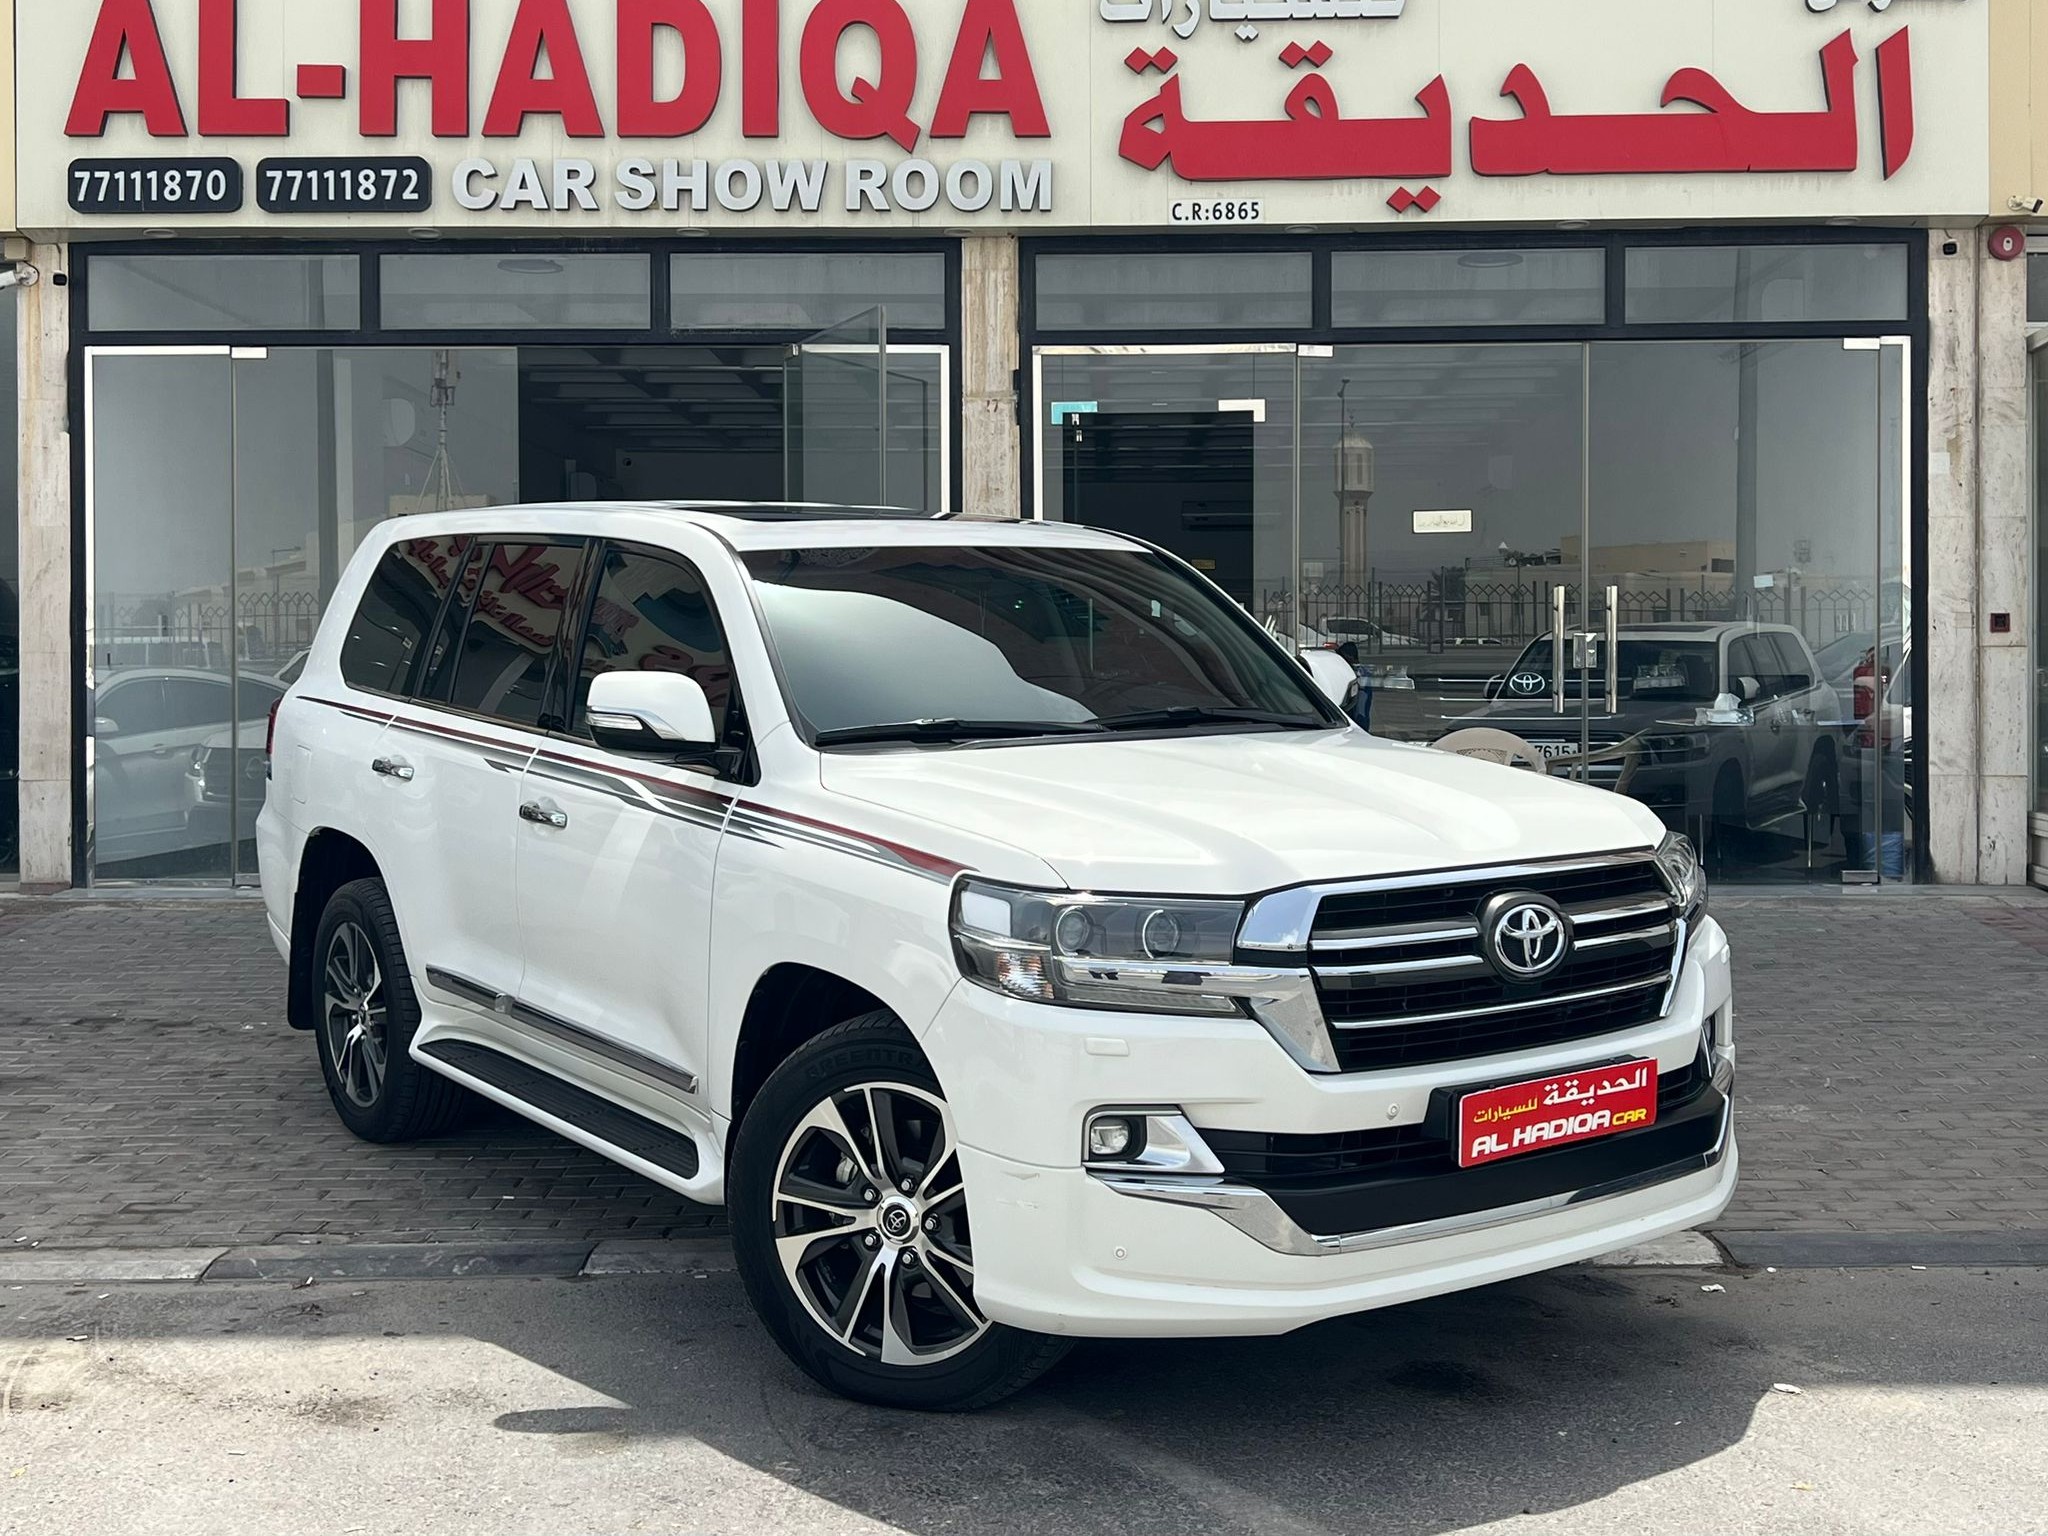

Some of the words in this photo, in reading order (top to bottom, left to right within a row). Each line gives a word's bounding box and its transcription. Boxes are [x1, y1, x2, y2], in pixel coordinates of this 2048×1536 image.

[64, 0, 1051, 153] AL-HADIQA
[1119, 25, 1914, 213] الحديقة
[74, 170, 227, 202] 77111870
[265, 168, 419, 201] 77111872
[451, 157, 600, 211] CAR
[614, 157, 829, 212] SHOW
[845, 158, 1053, 212] ROOM
[1473, 1098, 1538, 1123] للسيارات
[1543, 1067, 1647, 1106] الحديقة
[1471, 1133, 1508, 1158] AL
[1512, 1109, 1611, 1147] HADIQA
[1612, 1108, 1647, 1126] CAR
